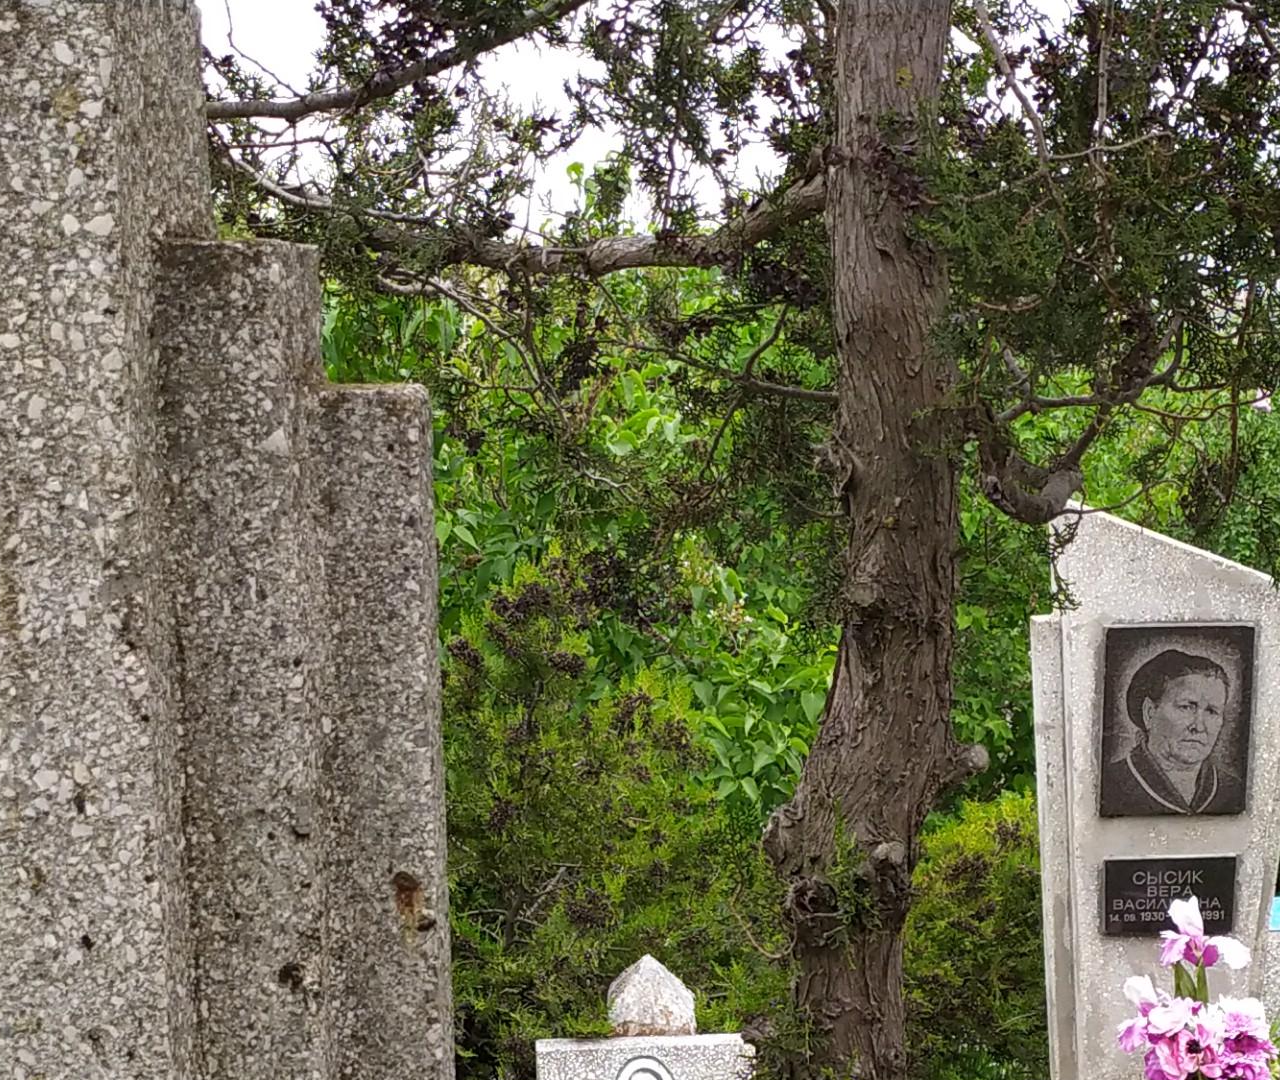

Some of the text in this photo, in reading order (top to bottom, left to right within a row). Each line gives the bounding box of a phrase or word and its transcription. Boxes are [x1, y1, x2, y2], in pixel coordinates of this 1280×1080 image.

[1133, 870, 1203, 885] СЫСИК
[1147, 886, 1193, 897] ВЕРА
[1113, 897, 1221, 910] ВАСИЛНА
